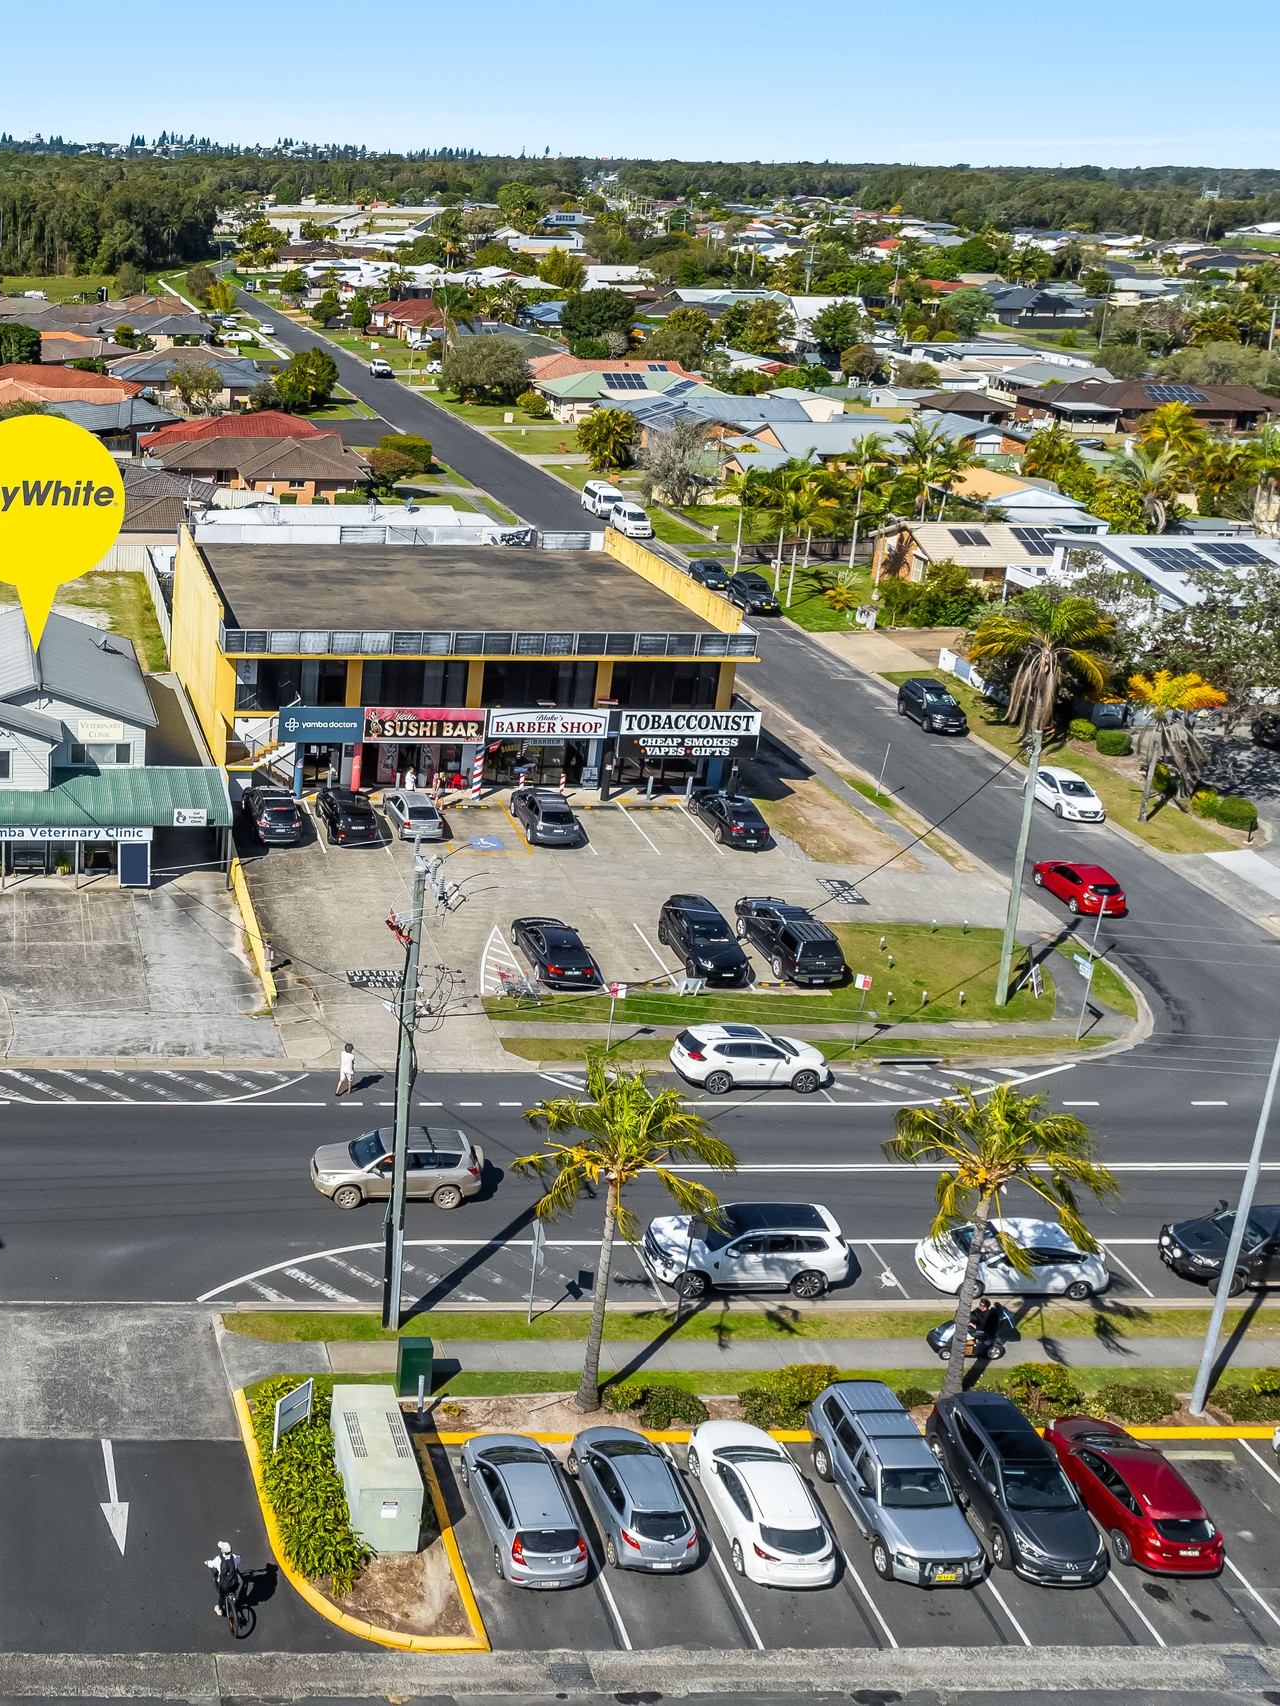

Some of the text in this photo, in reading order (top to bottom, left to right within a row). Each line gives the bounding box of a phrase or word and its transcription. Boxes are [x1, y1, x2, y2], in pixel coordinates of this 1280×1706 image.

[302, 720, 358, 729] yamba doctors
[495, 721, 602, 733] BARBER SHOP
[625, 714, 755, 732] TOBACCONIST
[383, 721, 479, 737] SUSHI BAR
[639, 738, 738, 746] CHEAP SMOKES
[645, 747, 730, 756] VAPES GIFTS
[29, 828, 101, 839] Veterinary
[106, 828, 143, 838] Clinic
